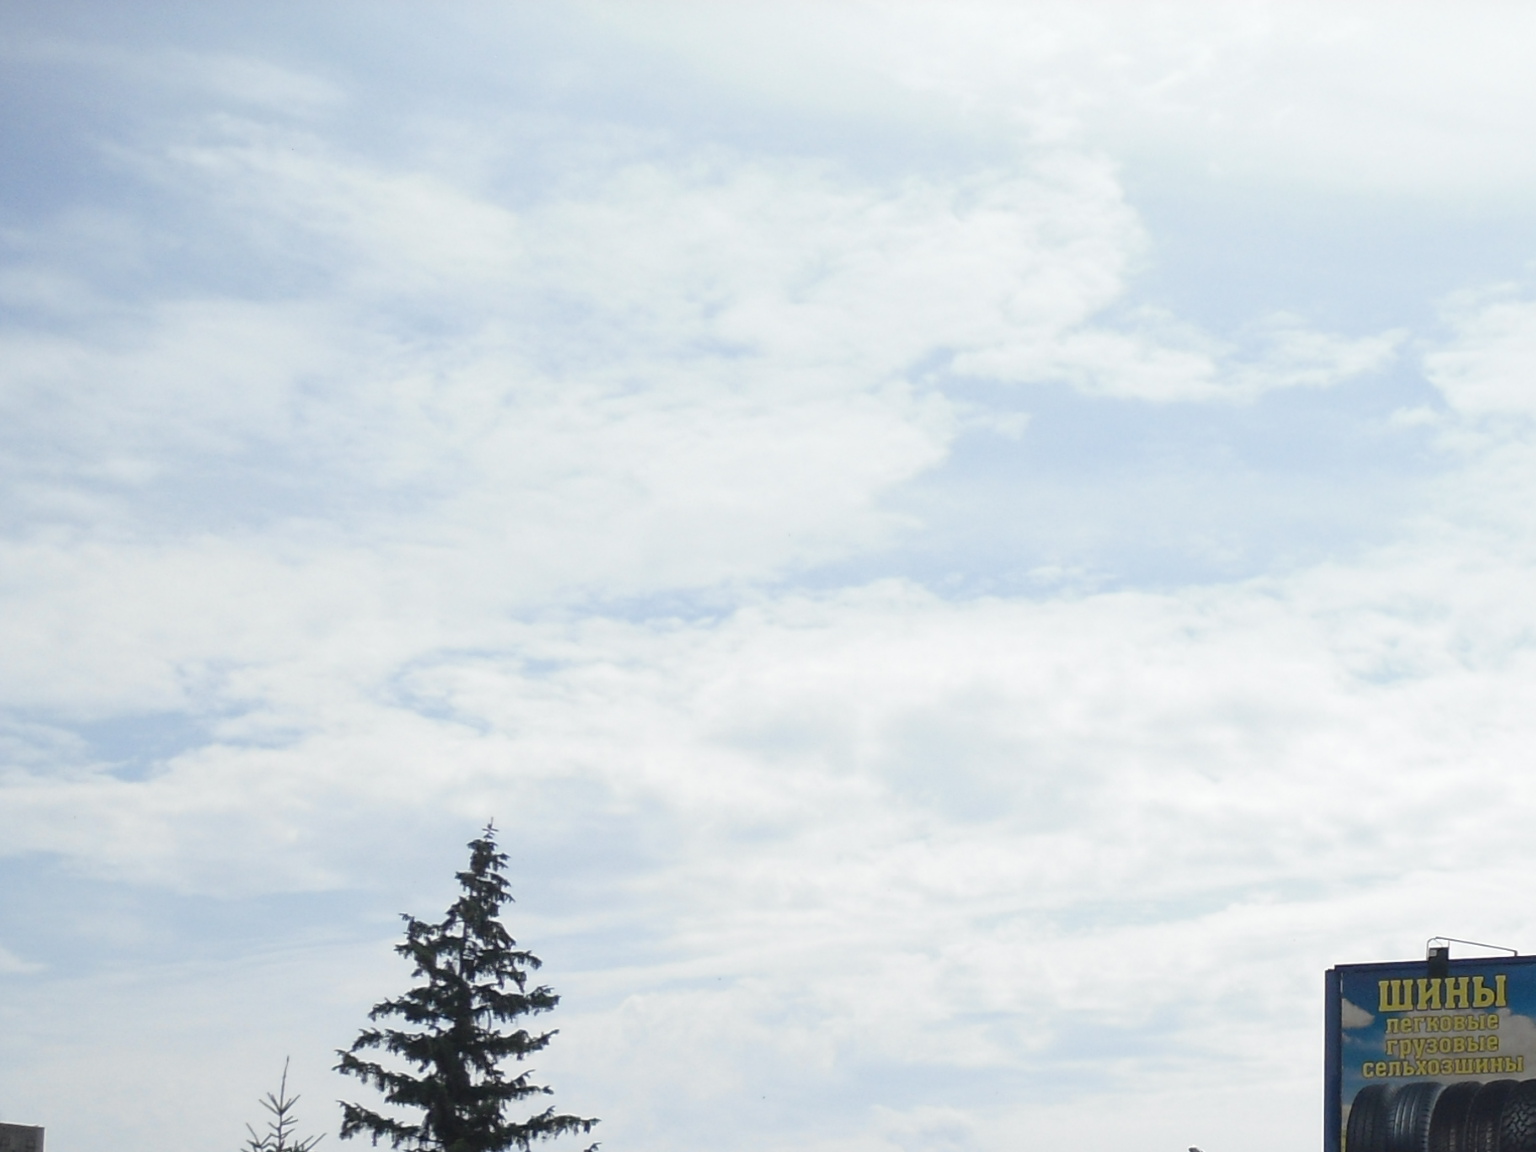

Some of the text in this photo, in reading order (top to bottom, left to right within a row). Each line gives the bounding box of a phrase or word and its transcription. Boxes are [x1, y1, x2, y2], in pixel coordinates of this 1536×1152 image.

[1378, 974, 1507, 1012] ШИНЫ
[1386, 1013, 1500, 1034] легковые
[1386, 1034, 1500, 1059] грузовые
[1361, 1056, 1525, 1078] сельхозшины
